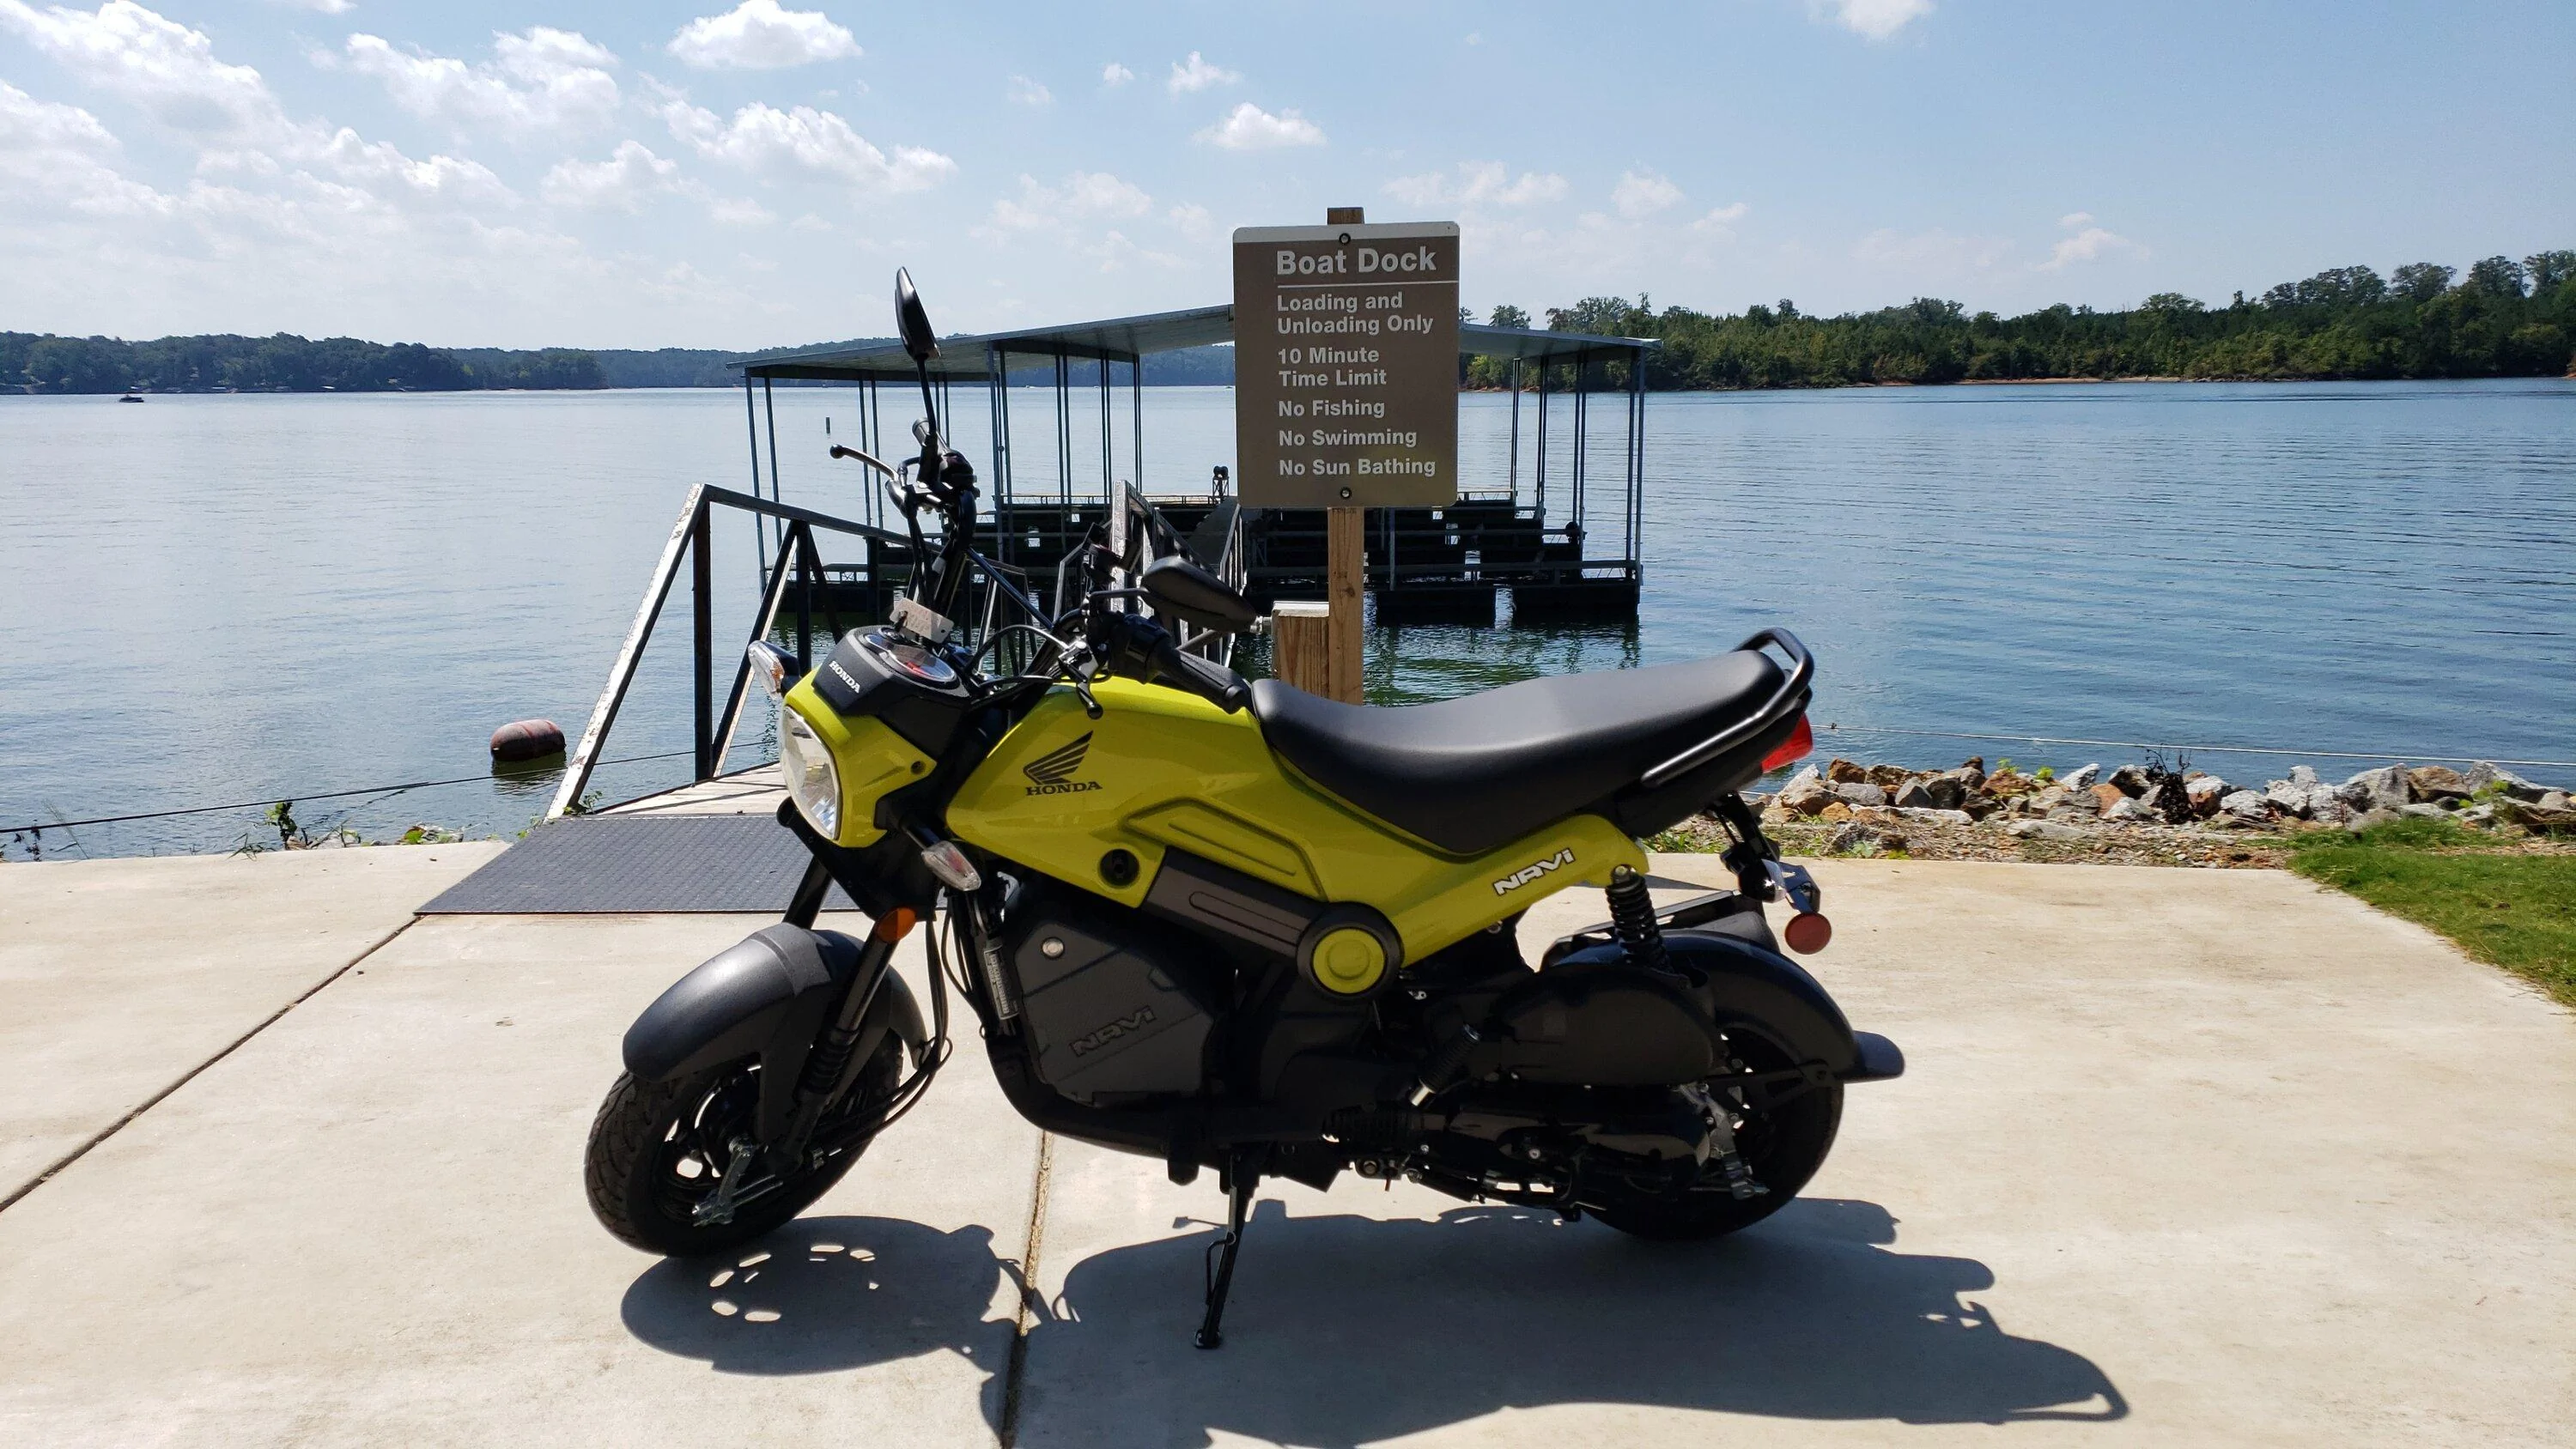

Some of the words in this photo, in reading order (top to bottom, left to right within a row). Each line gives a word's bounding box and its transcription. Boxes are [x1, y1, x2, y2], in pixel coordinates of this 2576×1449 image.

[1277, 250, 1347, 275] Boat
[1358, 246, 1437, 272] Dock
[1278, 294, 1358, 313] Loading
[1365, 291, 1403, 309] and
[1277, 315, 1380, 336] Unloading
[1387, 314, 1433, 335] Only
[1279, 348, 1302, 365] 10
[1309, 347, 1379, 364] Minute
[1279, 370, 1328, 386] Time
[1335, 368, 1387, 385] Limit
[1279, 401, 1305, 417] No
[1312, 399, 1385, 418] Fishing
[1279, 430, 1305, 446] No
[1312, 428, 1418, 447] Swimming
[1279, 459, 1306, 476] No
[1312, 459, 1351, 476] Sun
[1358, 458, 1436, 477] Bathing
[828, 660, 860, 694] HONDA
[1025, 781, 1103, 796] HONDA
[1492, 847, 1576, 896] NAVI
[1070, 1005, 1157, 1058] NAVI
